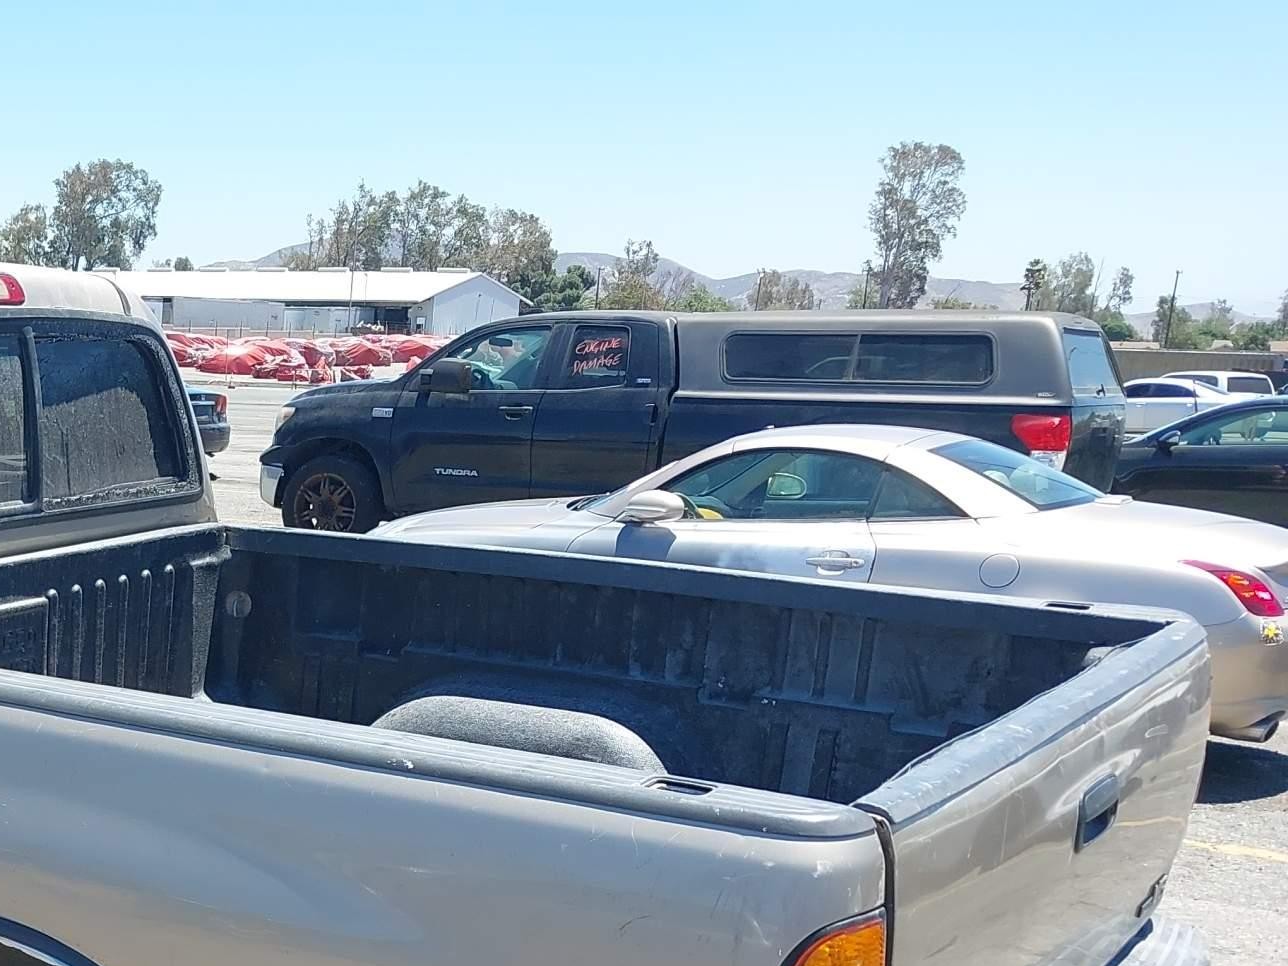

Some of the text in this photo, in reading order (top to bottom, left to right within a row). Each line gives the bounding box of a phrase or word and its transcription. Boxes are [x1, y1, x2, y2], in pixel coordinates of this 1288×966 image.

[575, 337, 622, 355] ENGINE
[572, 353, 623, 376] DAMAGE
[433, 468, 479, 477] TUNDRA
